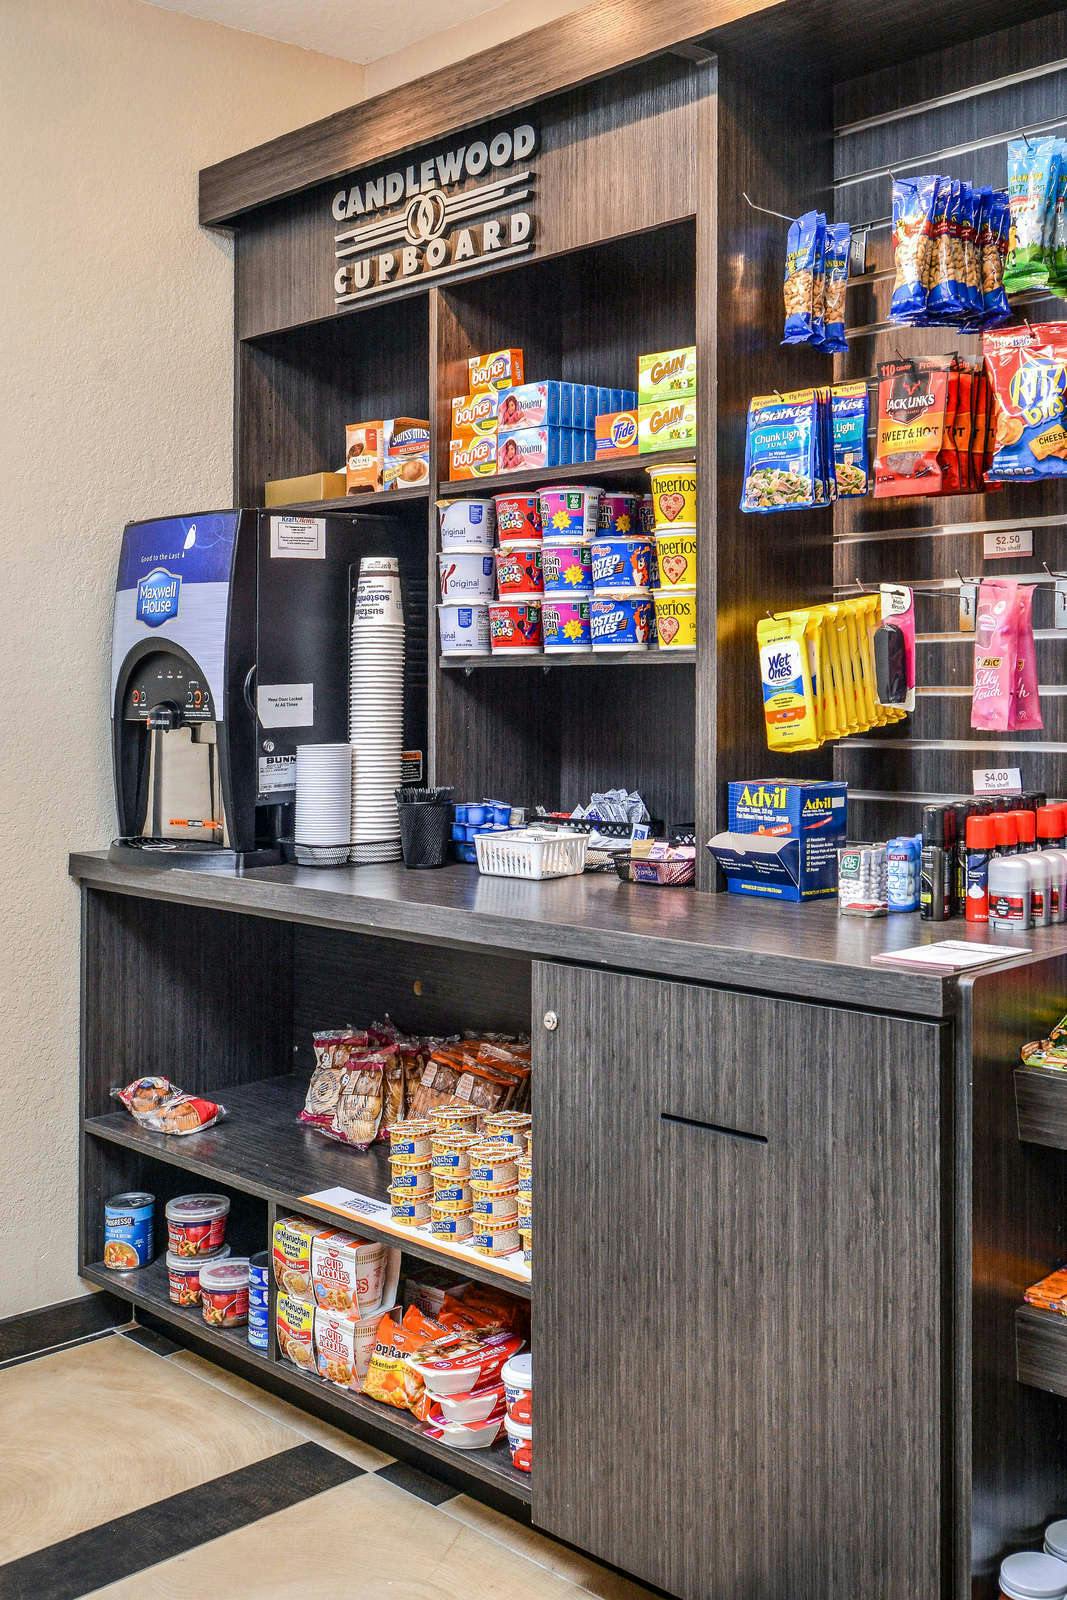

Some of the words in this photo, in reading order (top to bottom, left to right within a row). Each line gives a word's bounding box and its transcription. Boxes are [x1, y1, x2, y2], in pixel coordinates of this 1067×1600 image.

[332, 124, 536, 222] CANDLEWOOD
[333, 212, 531, 294] CUPBOARD
[472, 359, 505, 386] bounce
[881, 364, 896, 377] 110
[455, 399, 491, 426] bounce
[516, 398, 543, 411] Downy
[886, 397, 908, 413] JACK
[613, 421, 636, 443] Tide
[836, 422, 856, 433] Light
[881, 428, 909, 443] SWEET
[916, 426, 940, 438] HOT
[755, 432, 781, 445] Chunk
[767, 440, 787, 449] TUNA
[453, 442, 489, 468] bounce
[516, 443, 543, 456] Downy
[995, 534, 1021, 546] $2.50
[1007, 543, 1021, 552] shelf
[168, 552, 180, 560] Last
[139, 581, 177, 600] Maxwell
[449, 579, 480, 590] Original
[142, 599, 172, 615] House
[768, 652, 792, 669] Wet
[768, 665, 792, 681] Ones
[974, 668, 1000, 689] Silky
[973, 686, 1003, 703] Touch
[266, 756, 297, 765] BUNN
[984, 772, 1009, 782] $4.00
[996, 781, 1010, 789] shelf
[737, 785, 787, 809] Advil
[804, 797, 832, 810] Advil
[432, 1155, 454, 1167] Nacho
[435, 1189, 458, 1201] Nacho
[281, 1230, 308, 1249] Maruchan
[324, 1256, 344, 1271] CUP
[316, 1263, 351, 1285] NOODLES
[284, 1299, 310, 1319] Maruchan
[326, 1327, 344, 1344] CUP
[375, 1343, 389, 1357] op
